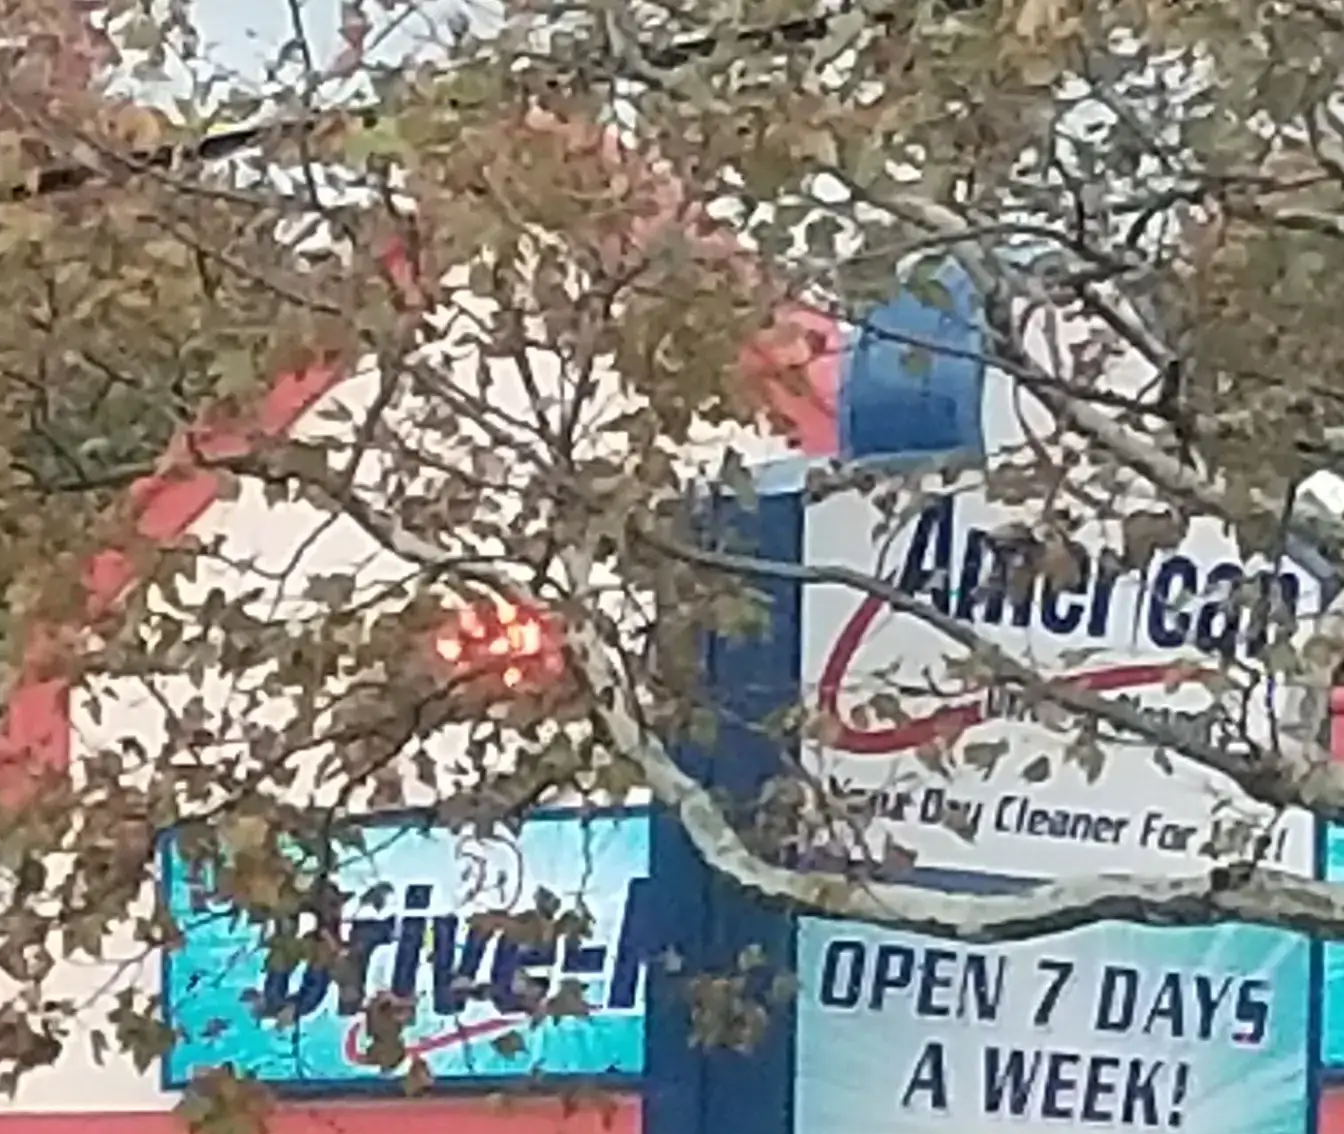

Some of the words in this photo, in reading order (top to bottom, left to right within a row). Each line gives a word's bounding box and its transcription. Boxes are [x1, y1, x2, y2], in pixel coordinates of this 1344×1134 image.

[994, 795, 1131, 846] Cleaner
[1140, 811, 1197, 851] For
[819, 940, 1006, 1021] OPEN
[1034, 960, 1074, 1026] 7
[1094, 965, 1271, 1044] DAYS
[901, 1043, 949, 1109] A
[983, 1046, 1189, 1127] WEEK!
